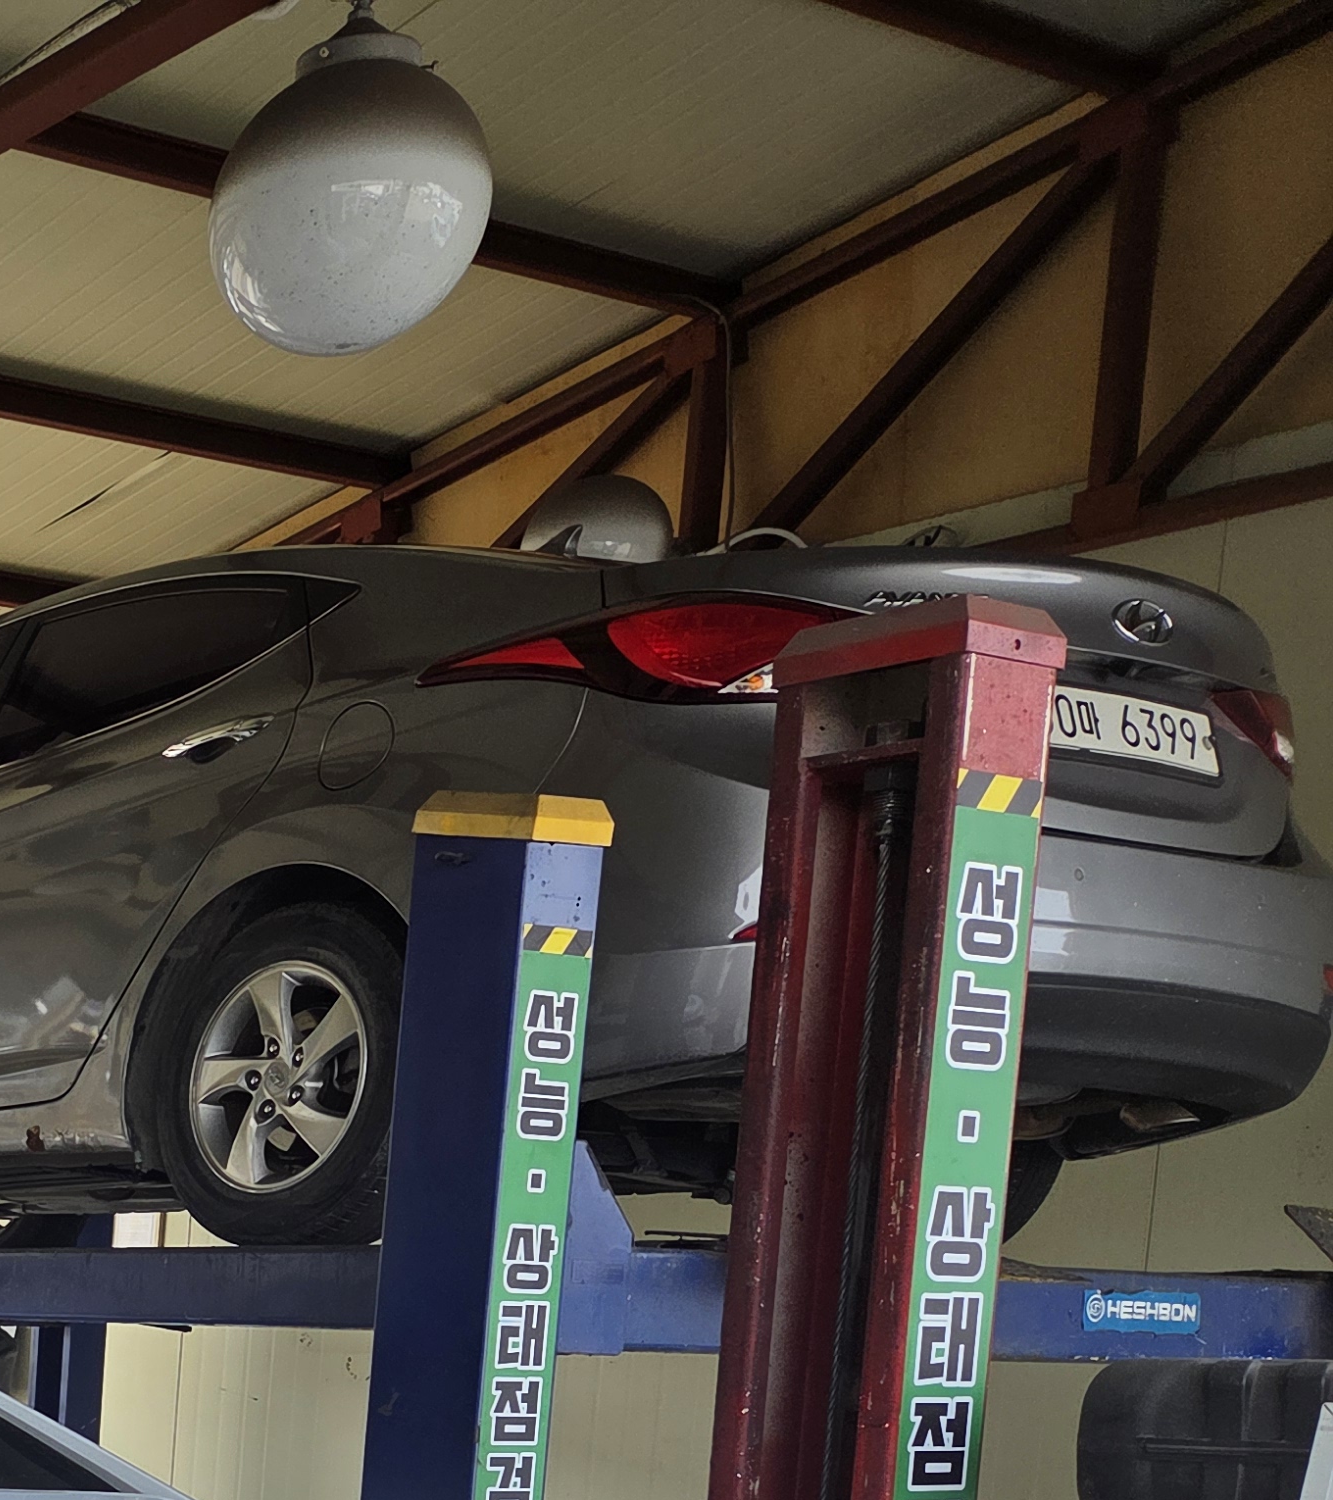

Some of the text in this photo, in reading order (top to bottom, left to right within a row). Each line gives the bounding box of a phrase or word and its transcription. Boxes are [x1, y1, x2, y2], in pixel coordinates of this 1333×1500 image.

[1053, 693, 1196, 760] 0마 6399
[1106, 1299, 1198, 1323] HESHBON
